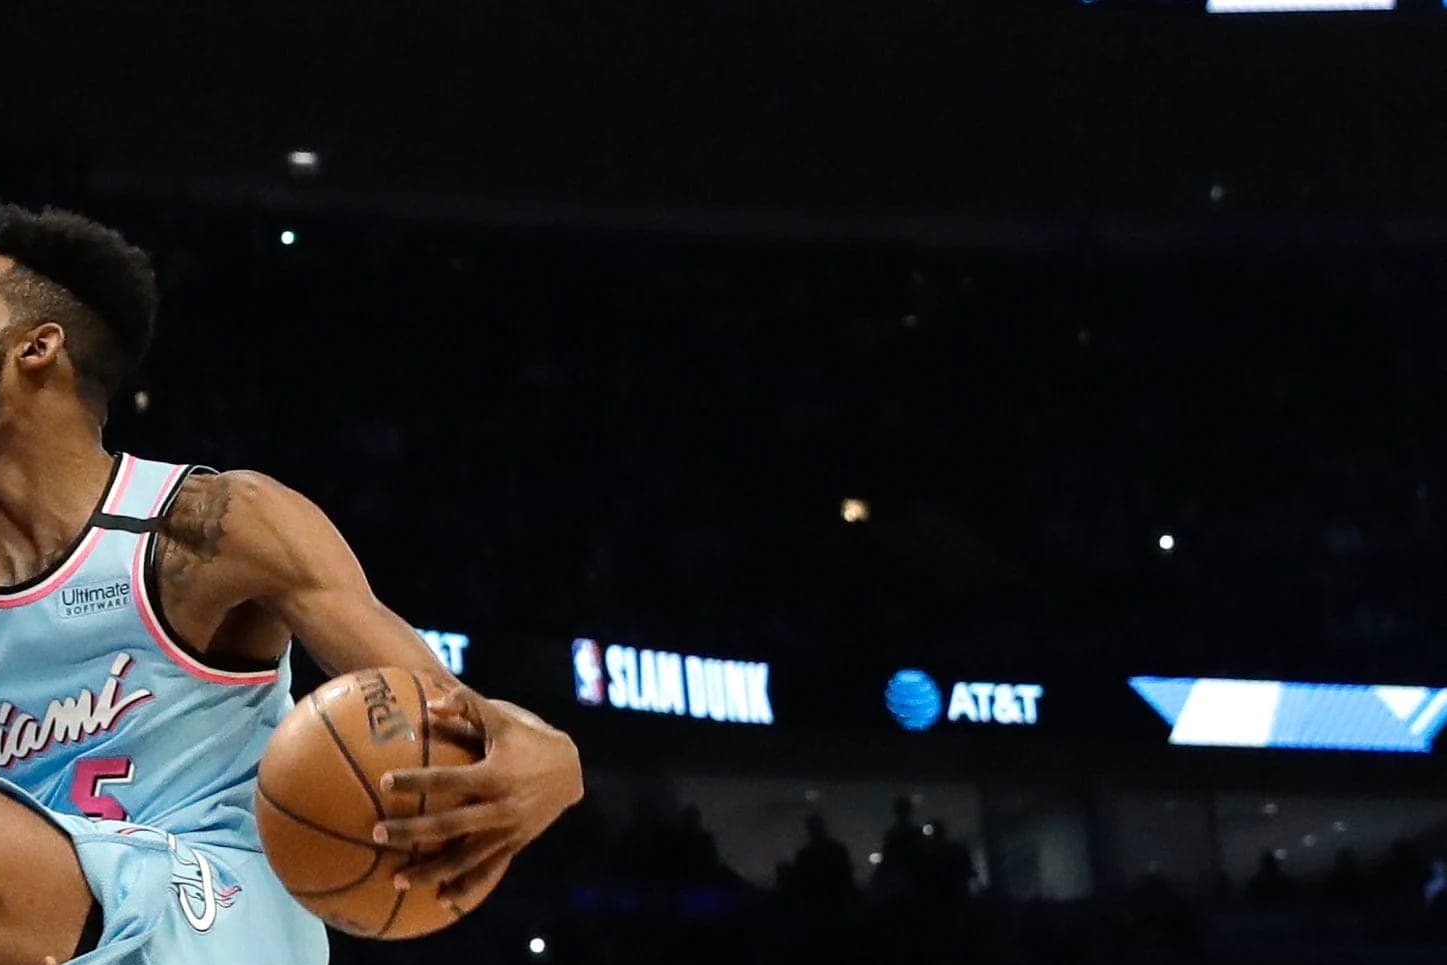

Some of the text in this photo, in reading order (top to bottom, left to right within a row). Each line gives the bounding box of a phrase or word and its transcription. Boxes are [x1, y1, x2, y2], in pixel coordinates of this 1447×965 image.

[62, 582, 130, 606] Ultimate
[65, 597, 129, 616] SOFTWARE
[605, 644, 774, 725] SLAM DUNK
[947, 682, 1043, 724] AT&T
[69, 756, 135, 822] 5
